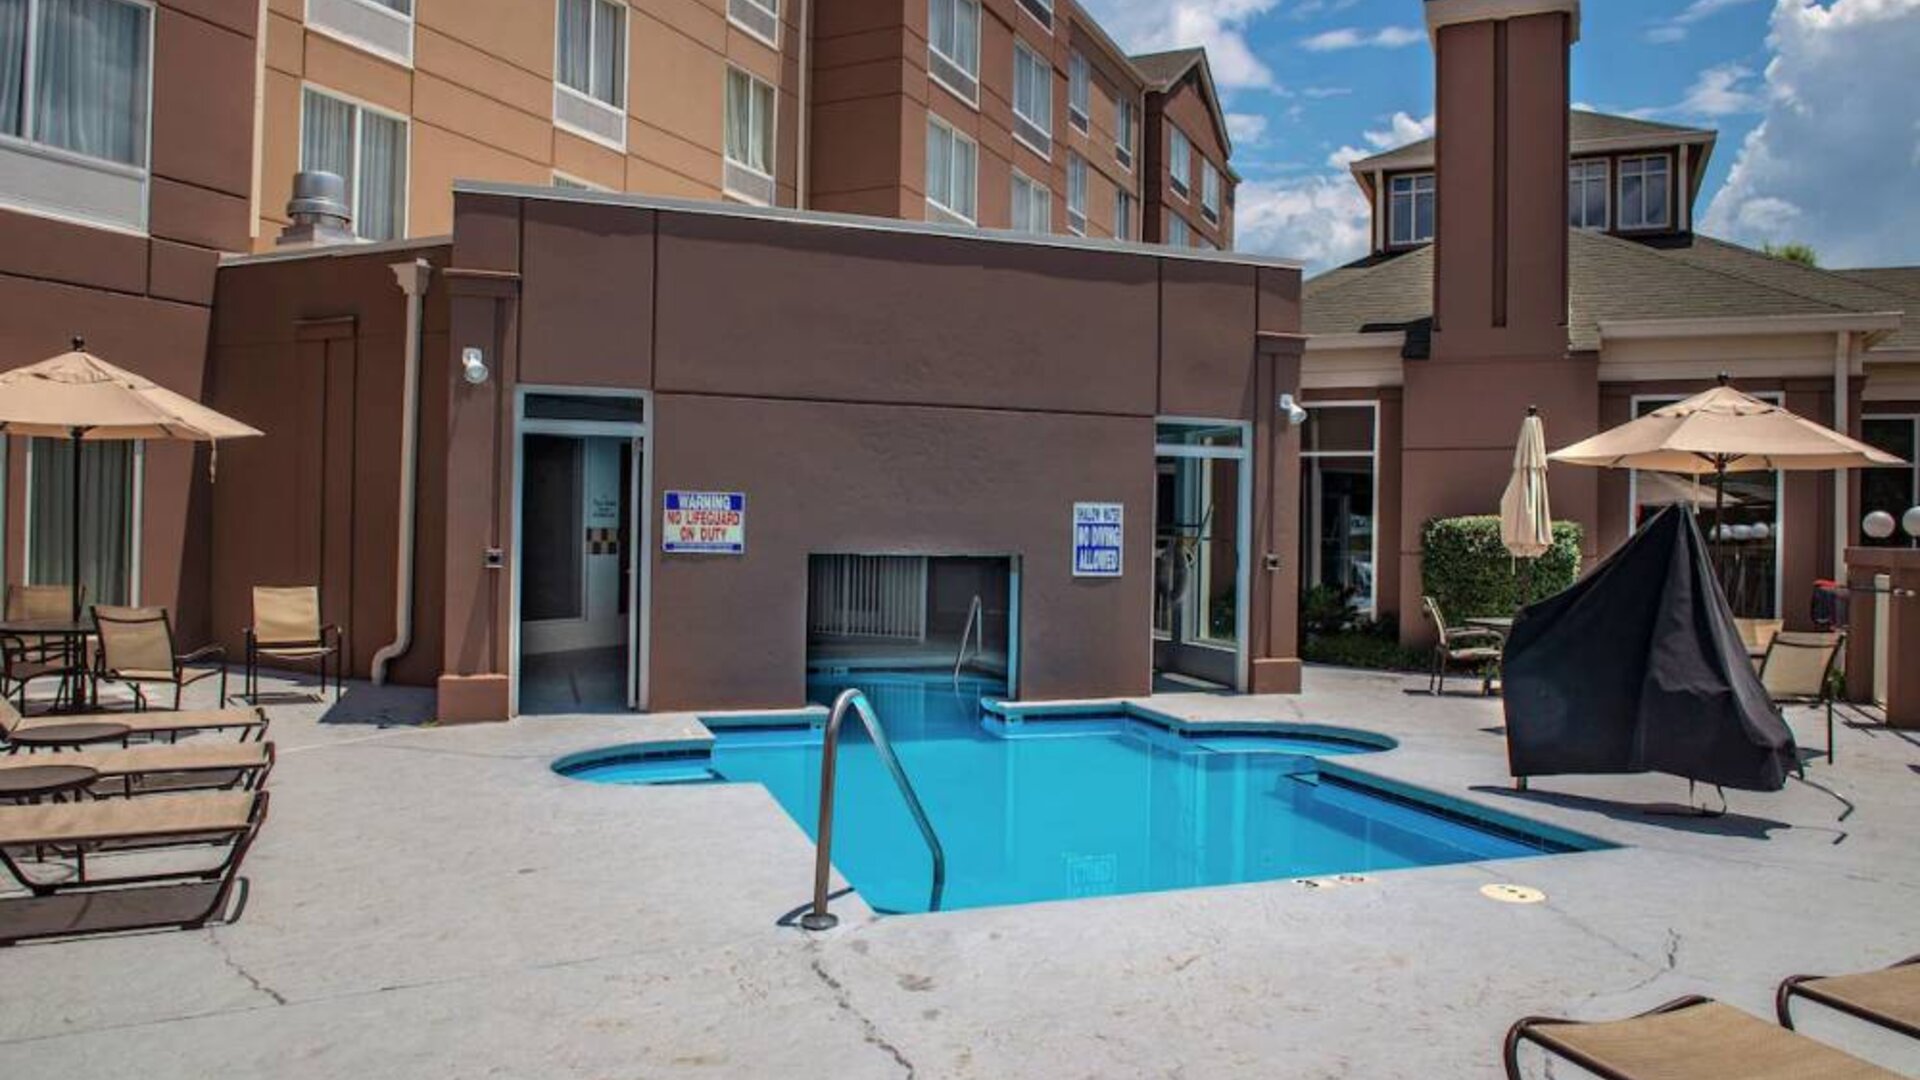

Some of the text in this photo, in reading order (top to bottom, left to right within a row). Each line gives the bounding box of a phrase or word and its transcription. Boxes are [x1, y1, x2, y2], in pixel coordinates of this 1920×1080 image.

[678, 494, 731, 510] WARNING
[667, 511, 740, 526] NO LIFEGUARD
[680, 526, 728, 541] ON DUTY
[1078, 525, 1120, 547] NO DIVING
[1079, 549, 1118, 570] ALLOWED
